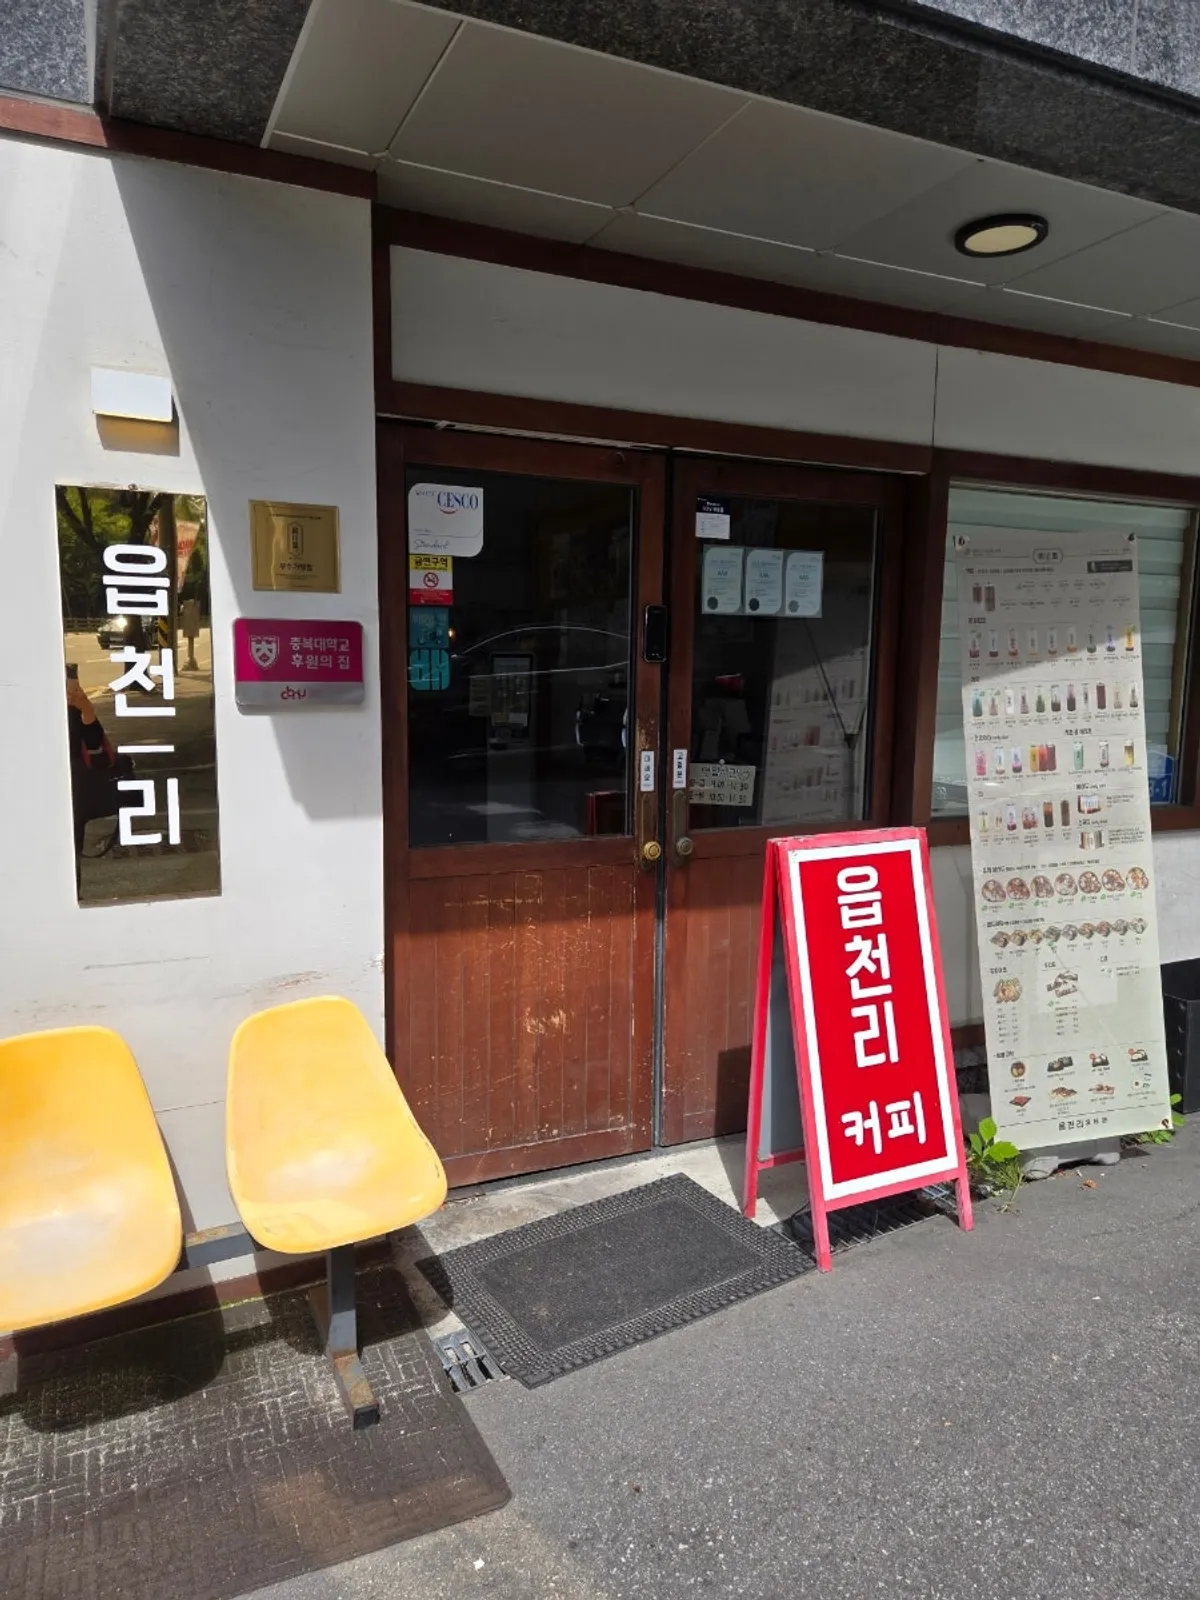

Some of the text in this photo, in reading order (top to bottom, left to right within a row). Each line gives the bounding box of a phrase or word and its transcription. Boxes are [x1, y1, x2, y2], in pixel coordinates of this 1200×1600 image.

[437, 490, 479, 510] CESCO
[414, 556, 448, 568] 금연구역
[289, 636, 350, 652] 충북대학교
[291, 653, 350, 670] 후원의 집
[836, 865, 899, 1069] 읍천리
[841, 1090, 927, 1155] 커피
